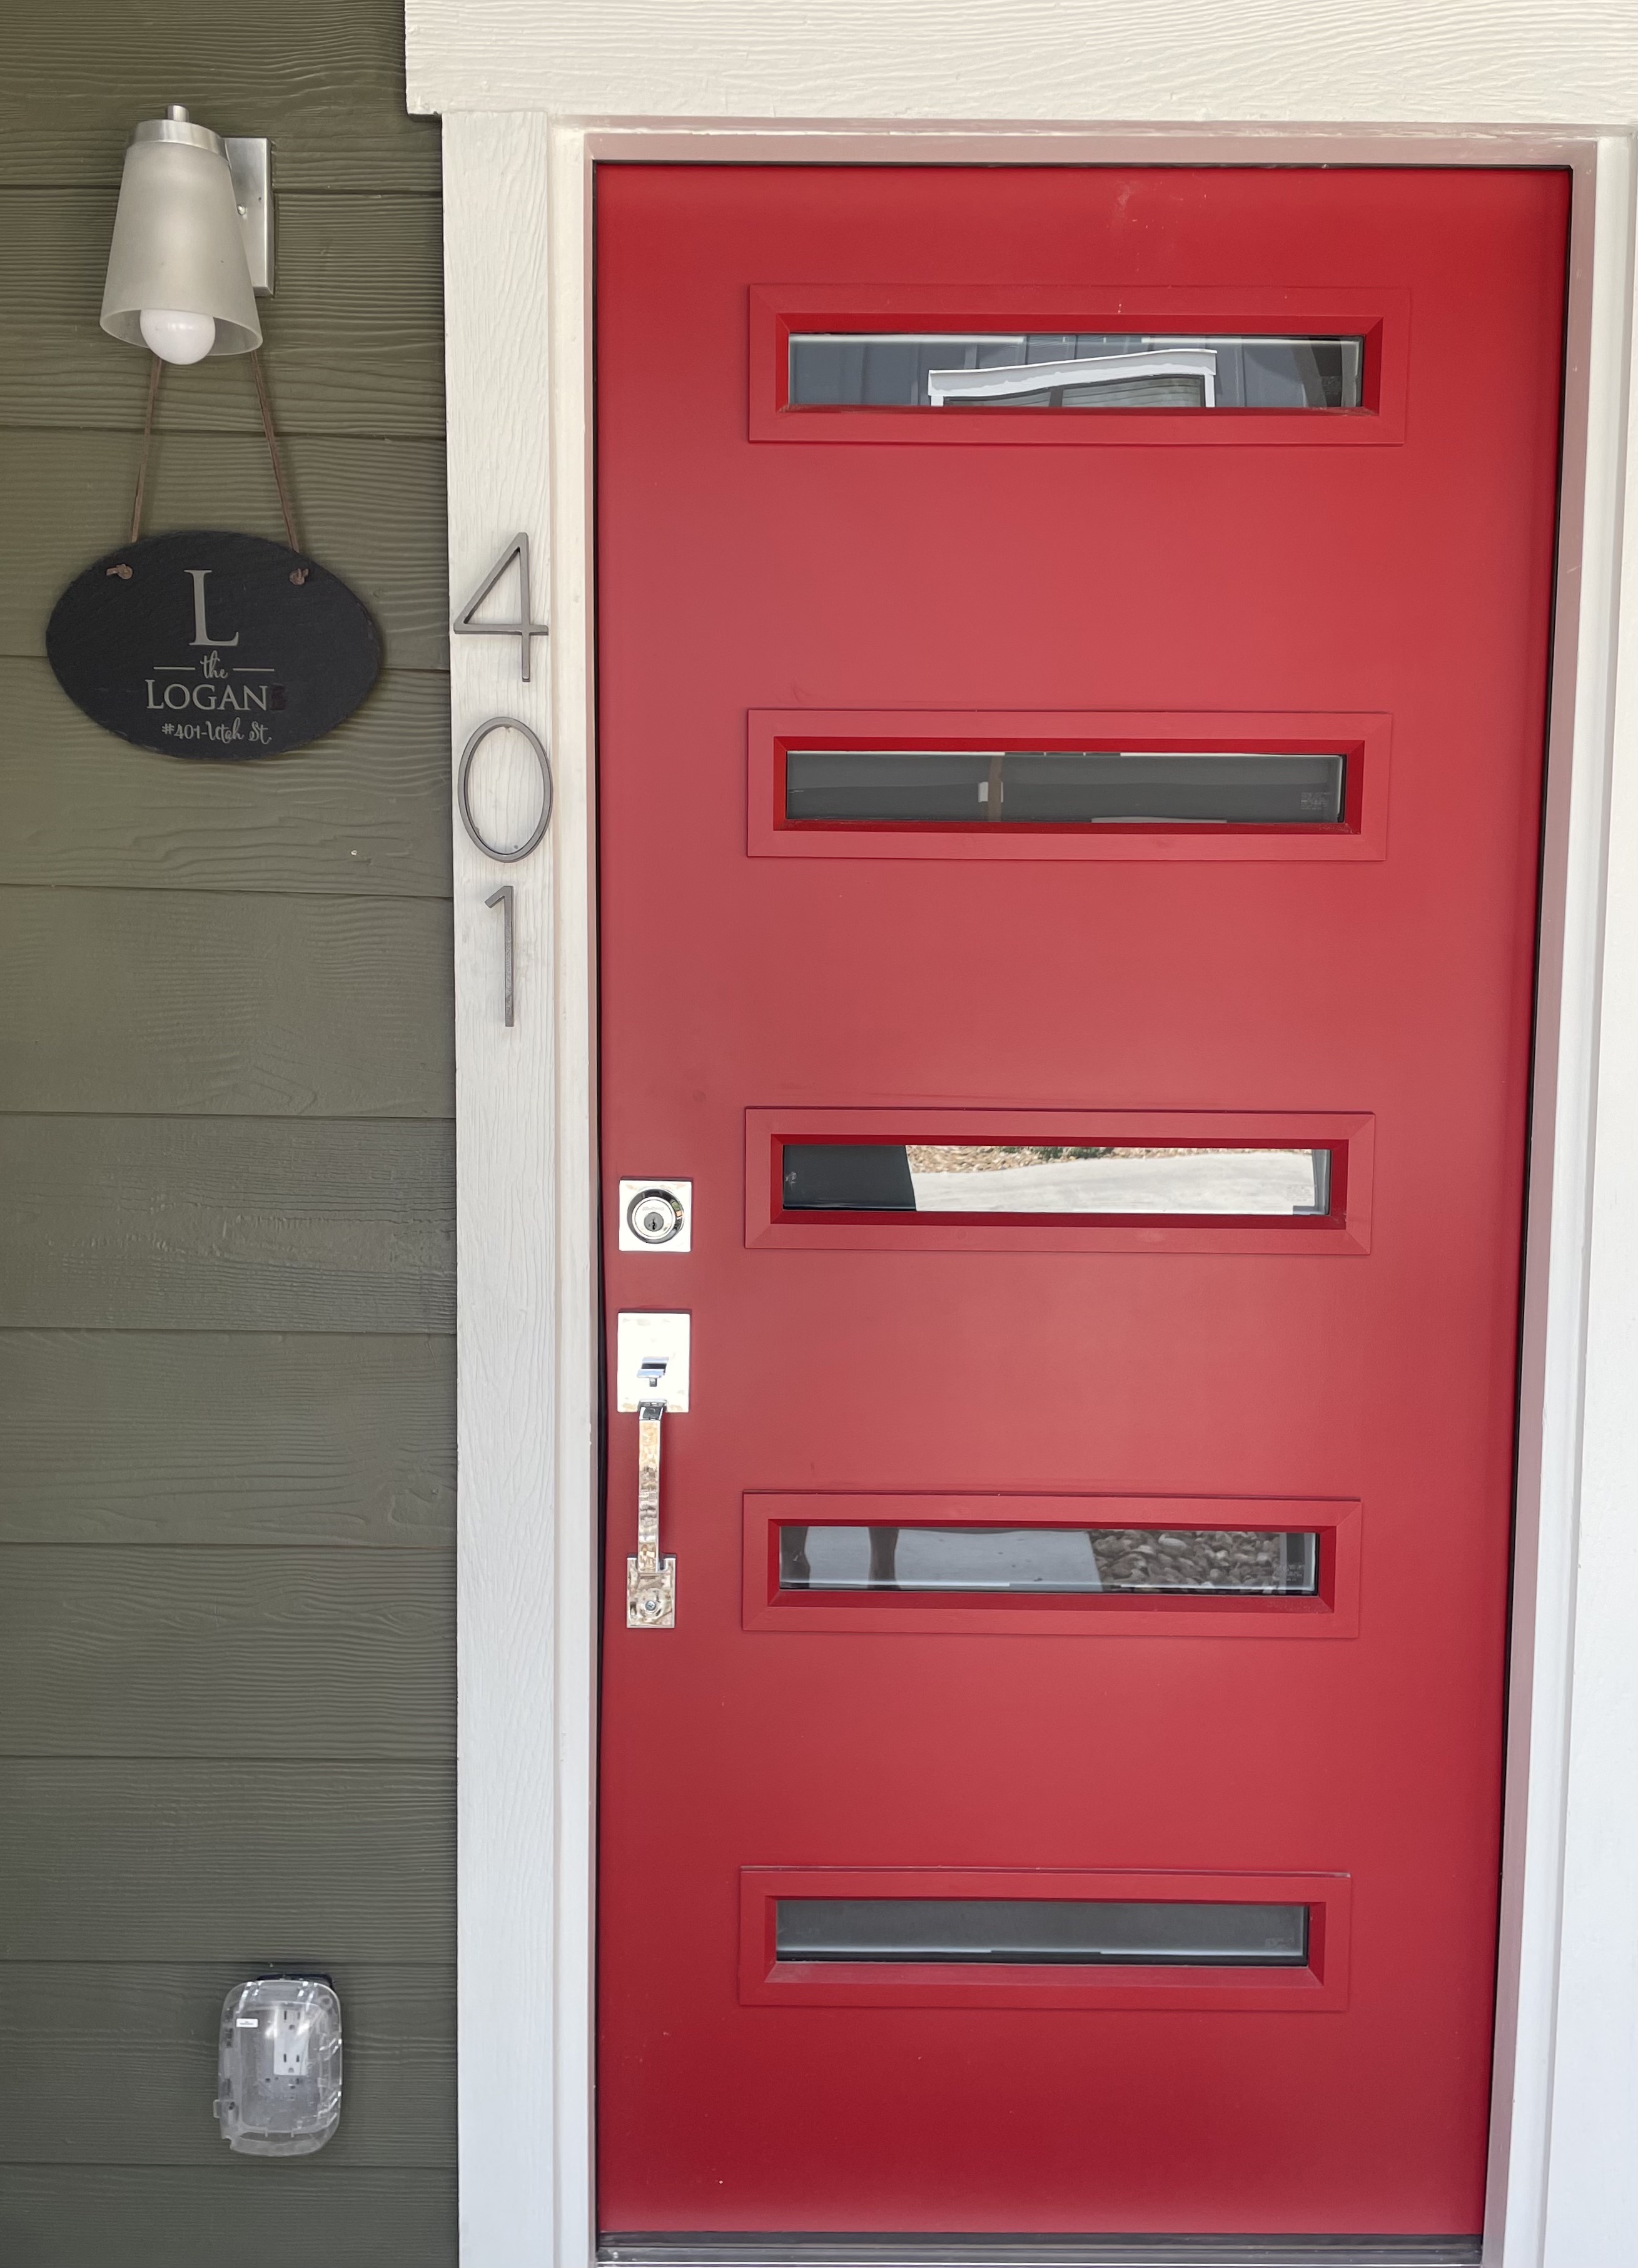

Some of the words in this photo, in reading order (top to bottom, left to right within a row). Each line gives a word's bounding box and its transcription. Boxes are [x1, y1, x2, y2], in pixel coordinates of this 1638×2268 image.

[184, 569, 239, 646] L
[200, 650, 228, 679] the
[144, 679, 268, 711] LOGAN
